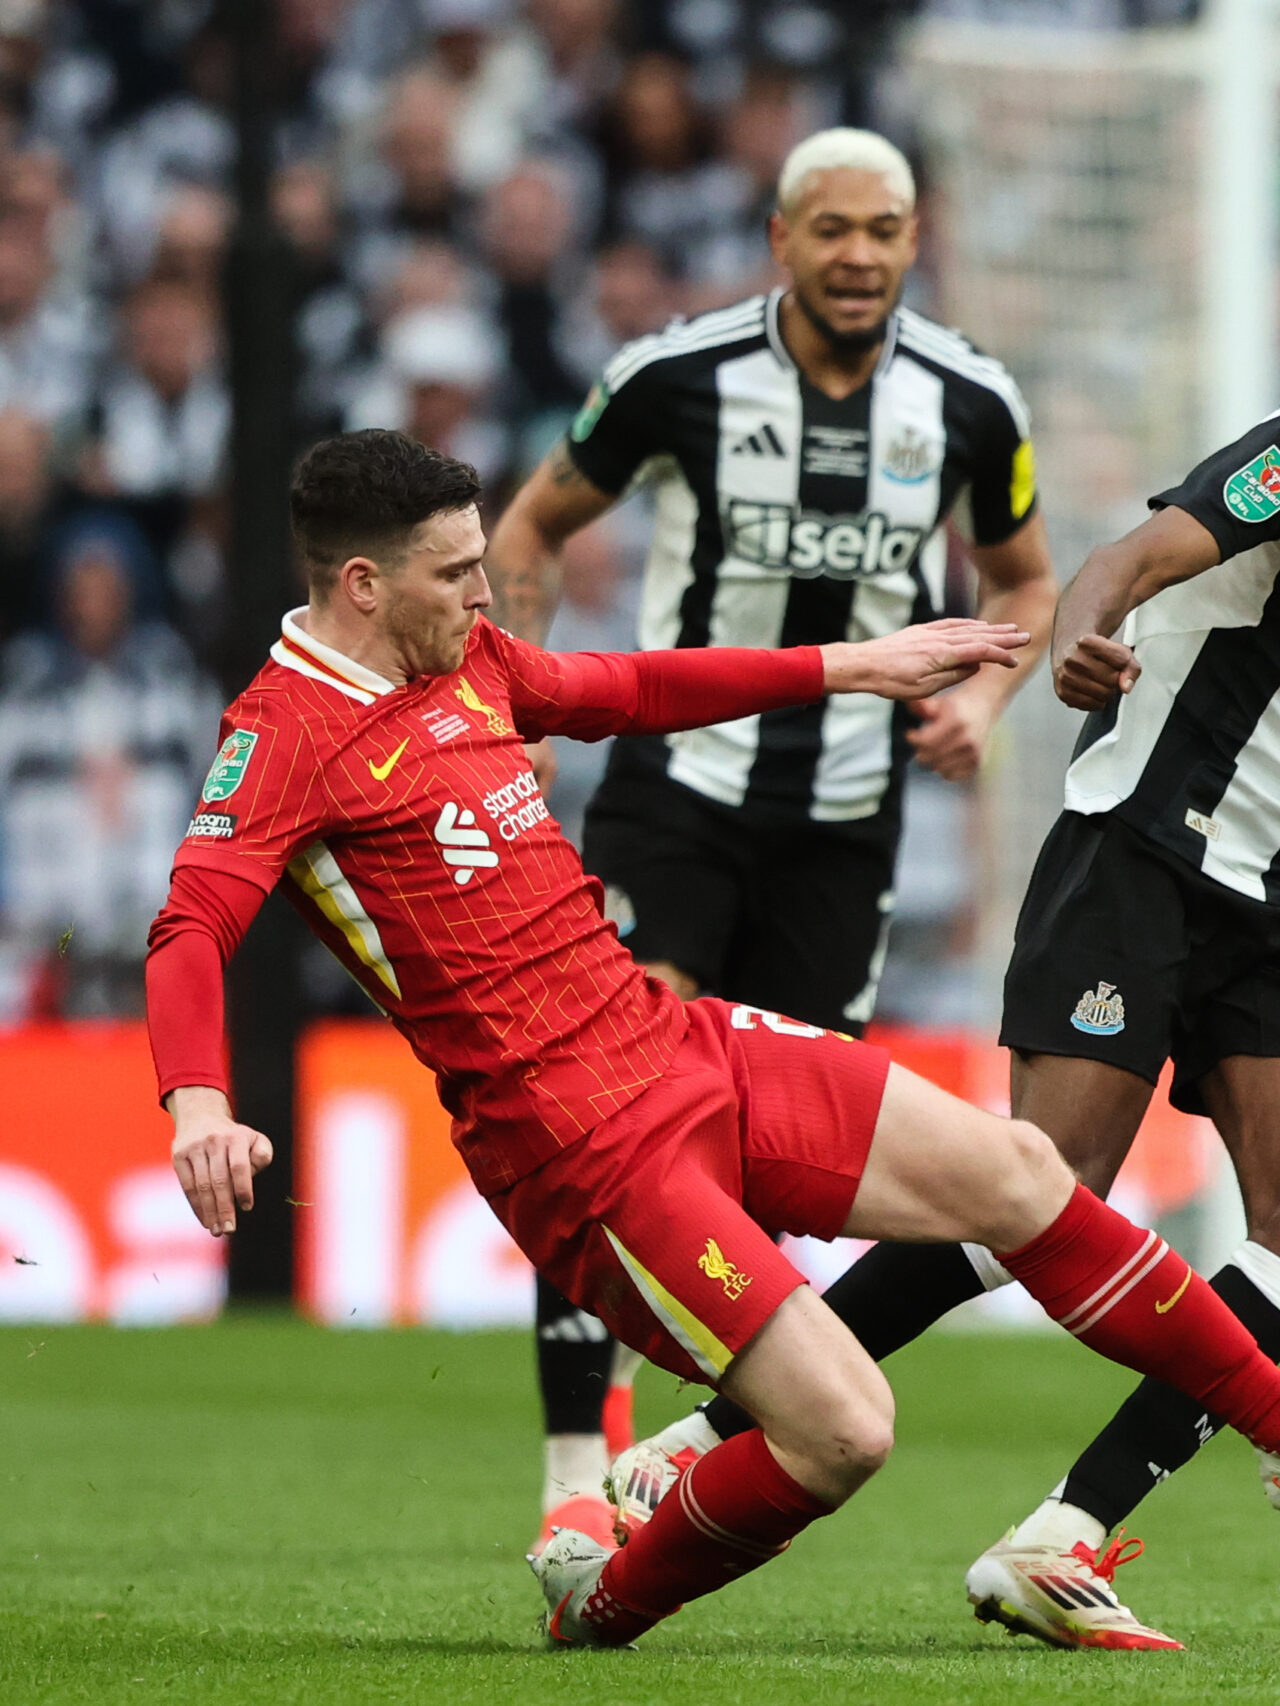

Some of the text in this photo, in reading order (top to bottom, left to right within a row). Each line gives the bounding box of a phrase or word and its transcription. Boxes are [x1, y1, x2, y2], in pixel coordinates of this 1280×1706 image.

[1243, 484, 1264, 503] Cup
[482, 770, 540, 819] standa
[195, 814, 232, 828] room
[499, 796, 551, 841] charte
[190, 825, 234, 838] racism
